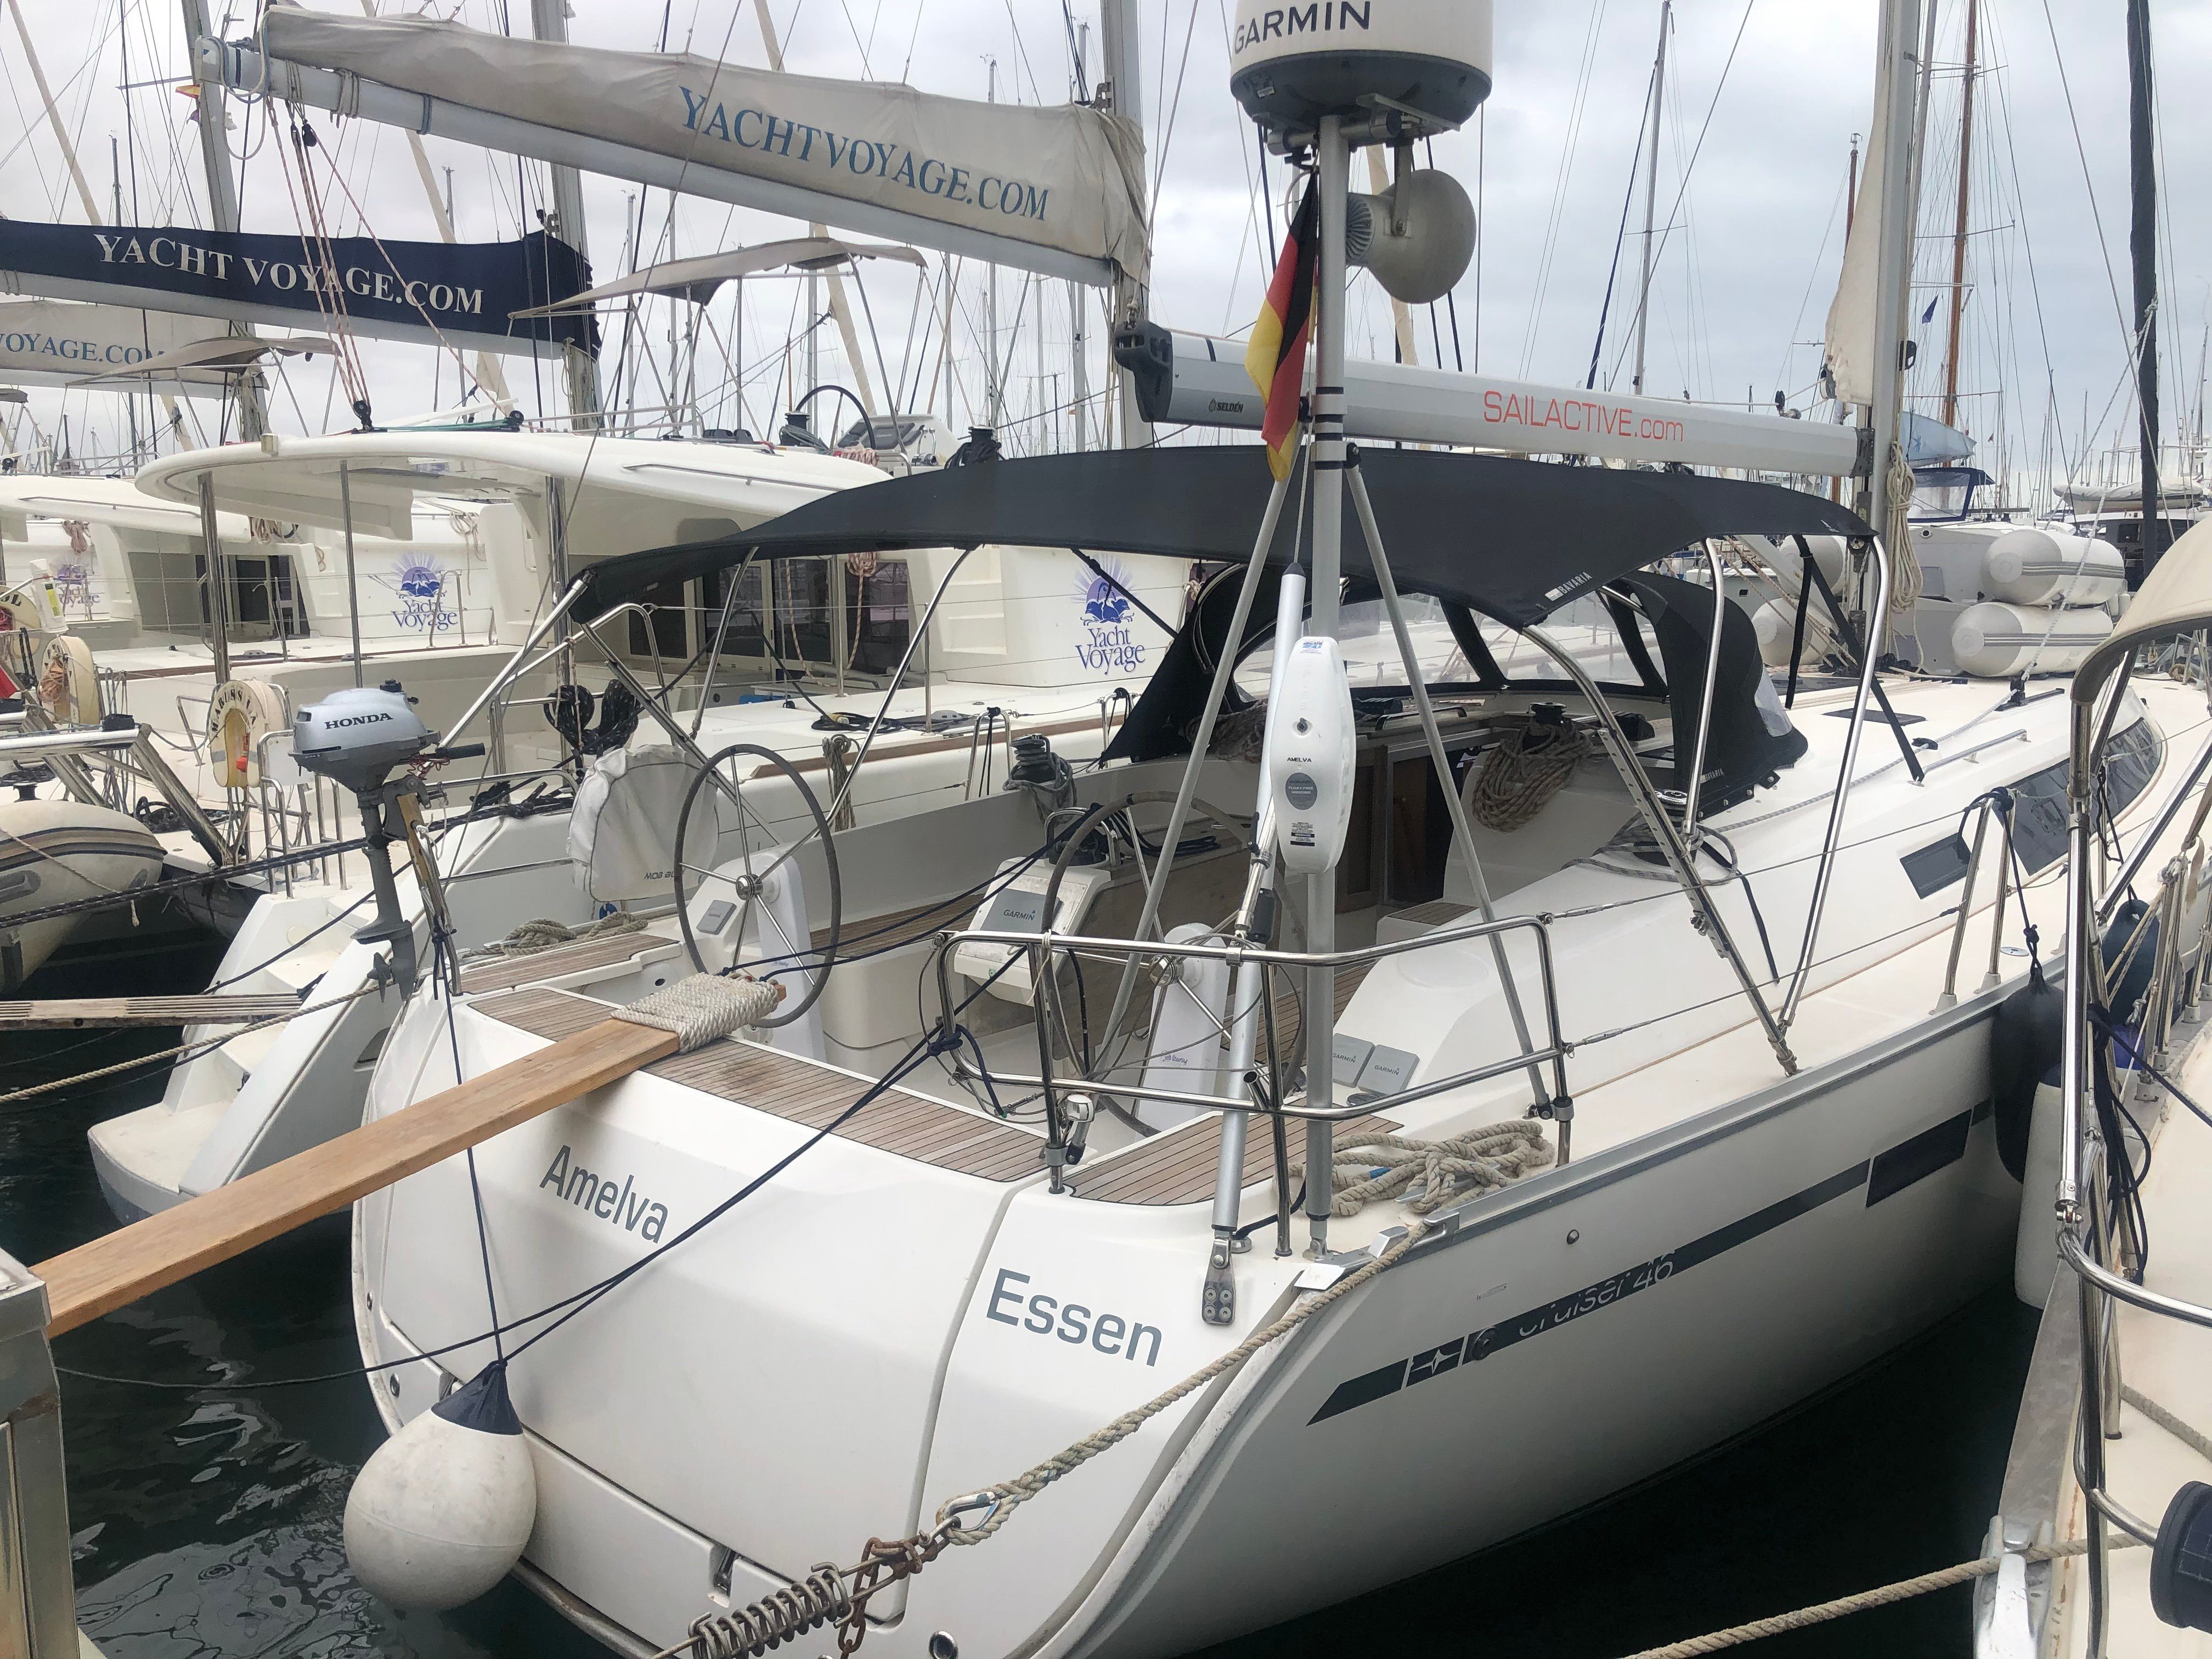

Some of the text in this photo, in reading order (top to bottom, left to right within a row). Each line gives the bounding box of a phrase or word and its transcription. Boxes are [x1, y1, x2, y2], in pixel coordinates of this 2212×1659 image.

[1234, 1, 1370, 55] GARMIN
[679, 86, 1049, 222] YACHTVOYAGE.COM
[93, 233, 484, 314] YACHT VOYAGE.COM
[0, 333, 165, 365] OYAGE.CO
[1217, 401, 1244, 413] SELDÉN
[1483, 391, 1684, 442] SAILACTIVE.com
[1558, 572, 1593, 594] BAVARIA
[403, 599, 443, 614] Yacht
[391, 611, 458, 631] Voyage
[1087, 625, 1131, 647] Yacht
[1075, 644, 1146, 675] Voyage
[324, 713, 393, 730] HONDA
[644, 871, 663, 879] MOB
[1003, 909, 1035, 921] GARMIN
[1374, 1065, 1400, 1075] GARMIN
[539, 1144, 668, 1244] Amelva
[1633, 1250, 1675, 1288] 46
[986, 1268, 1162, 1367] Essen
